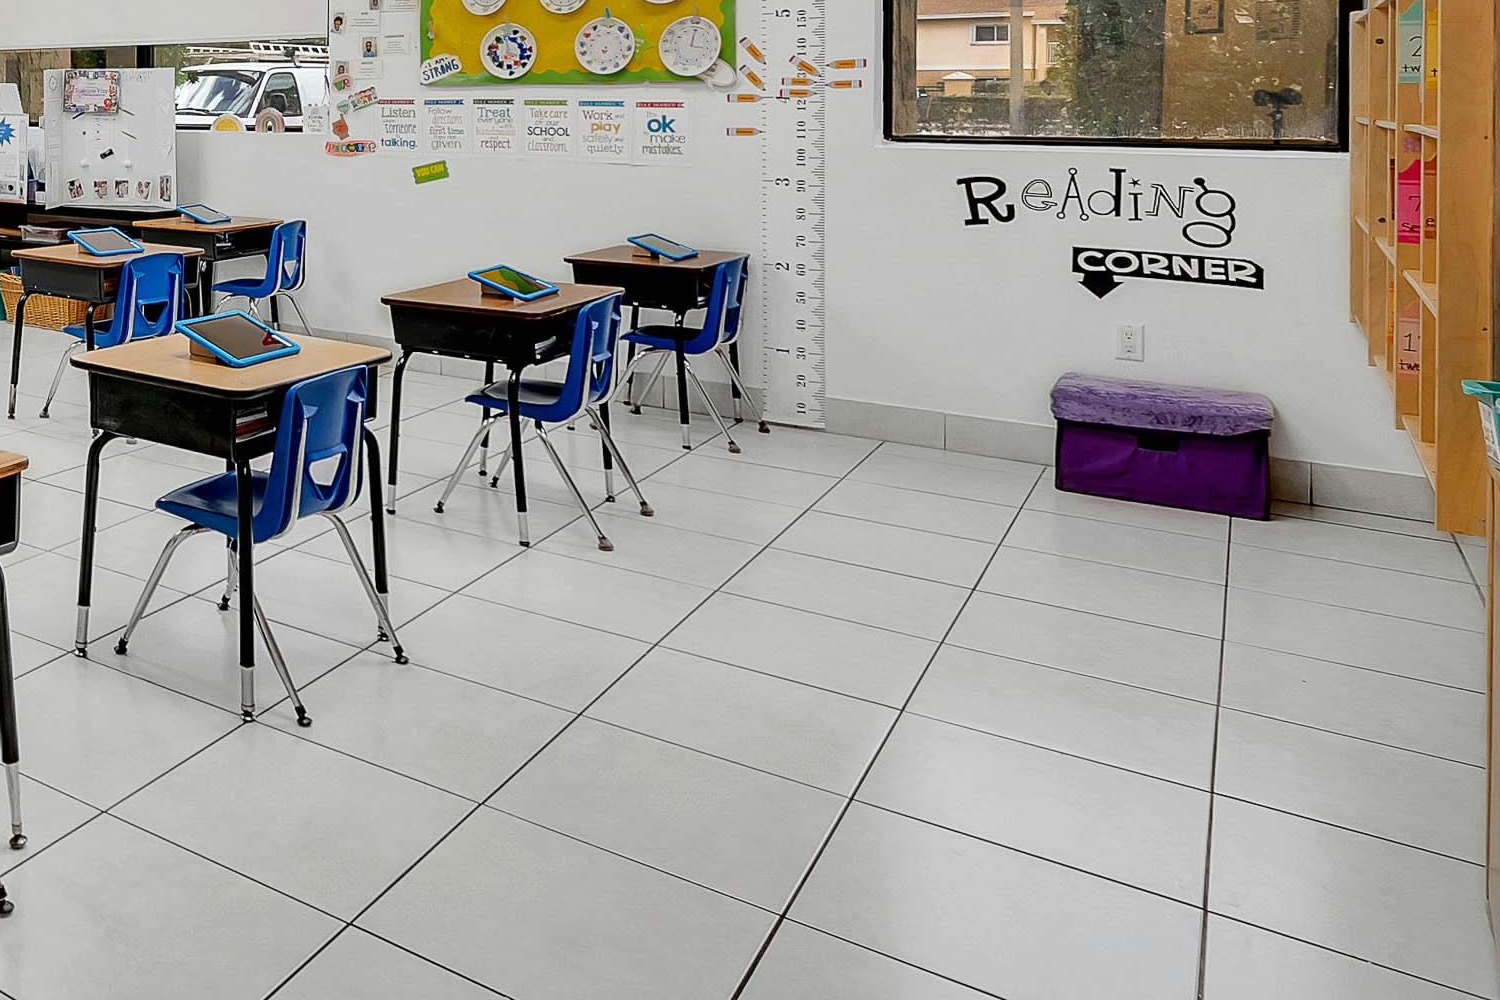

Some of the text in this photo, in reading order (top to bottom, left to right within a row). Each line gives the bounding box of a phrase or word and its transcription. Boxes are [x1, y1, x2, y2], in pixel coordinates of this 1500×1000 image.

[775, 8, 791, 18] 5
[797, 9, 806, 28] 150
[797, 37, 806, 56] 140
[422, 59, 459, 81] STRONG
[381, 107, 416, 118] Listen
[477, 107, 511, 118] Treat
[530, 108, 548, 119] Take
[582, 110, 613, 121] Work
[590, 121, 621, 134] play
[647, 115, 676, 133] ok
[797, 120, 806, 139] 110
[527, 126, 570, 137] SCHOOL
[650, 133, 686, 144] make
[797, 148, 806, 168] 100
[775, 177, 791, 187] 3
[796, 179, 806, 192] 90
[796, 207, 806, 221] 80
[796, 235, 806, 248] 70
[775, 262, 790, 271] 2
[796, 263, 806, 277] 60
[1077, 250, 1258, 283] CORNER
[796, 291, 806, 304] 50
[796, 319, 806, 332] 40
[796, 346, 806, 360] 30
[796, 374, 806, 388] 20
[796, 402, 806, 416] 10
